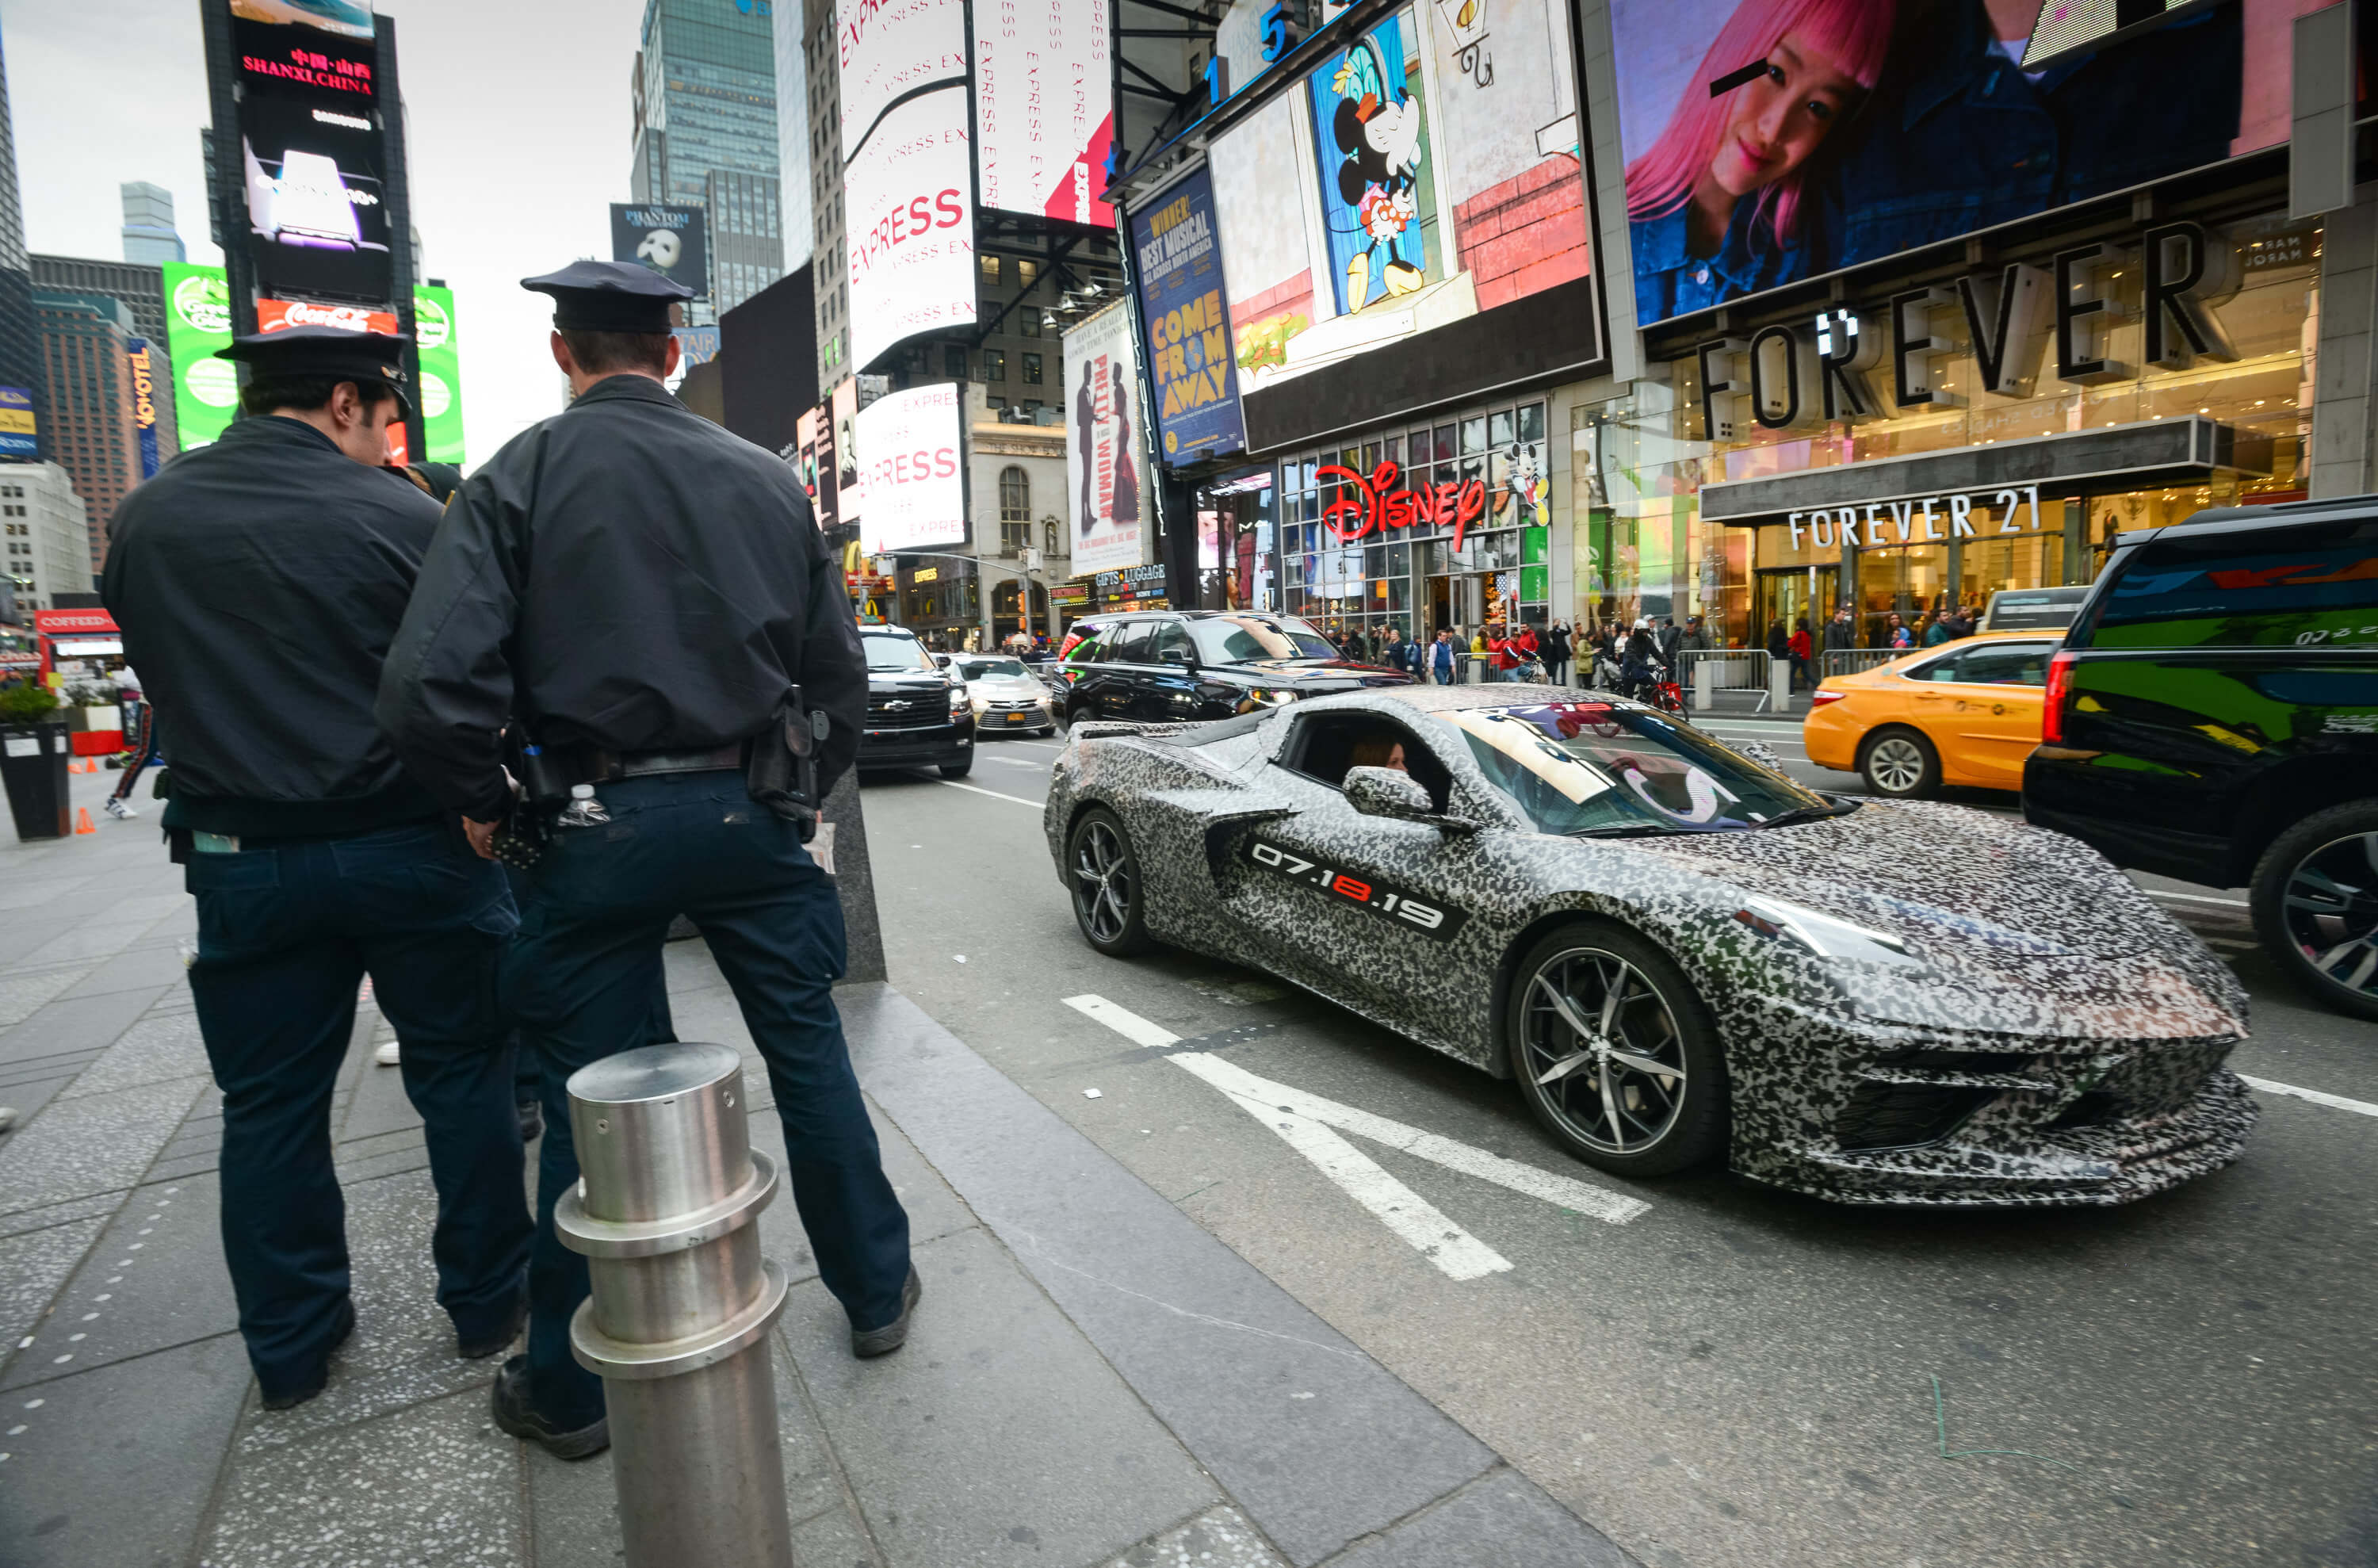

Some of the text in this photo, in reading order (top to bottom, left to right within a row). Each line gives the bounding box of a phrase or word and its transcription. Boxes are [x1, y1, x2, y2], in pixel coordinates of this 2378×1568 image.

[243, 55, 372, 95] SHANXI,CHINA
[1027, 52, 1042, 143] EXPRESS
[625, 211, 689, 224] PHANTOM
[851, 189, 963, 285] EXPRESS
[1140, 210, 1210, 273] BEST MUSICAL
[1149, 194, 1191, 238] WINNER!
[1143, 271, 1154, 286] ALL
[1189, 235, 1213, 261] AMERICA
[285, 303, 371, 324] Coca-Cola
[1152, 289, 1223, 350] COME
[1697, 221, 2212, 442] FOREVER
[129, 347, 156, 429] NOVOTEL
[1094, 354, 1110, 426] PRETTY
[1162, 360, 1228, 419] AWAY
[1097, 438, 1113, 519] WOMAN
[1315, 461, 1485, 553] Disney
[1789, 487, 2041, 551] FOREVER 21
[1095, 564, 1165, 587] GIFTS LUGGAGE
[1252, 843, 1444, 929] 07.18.19
